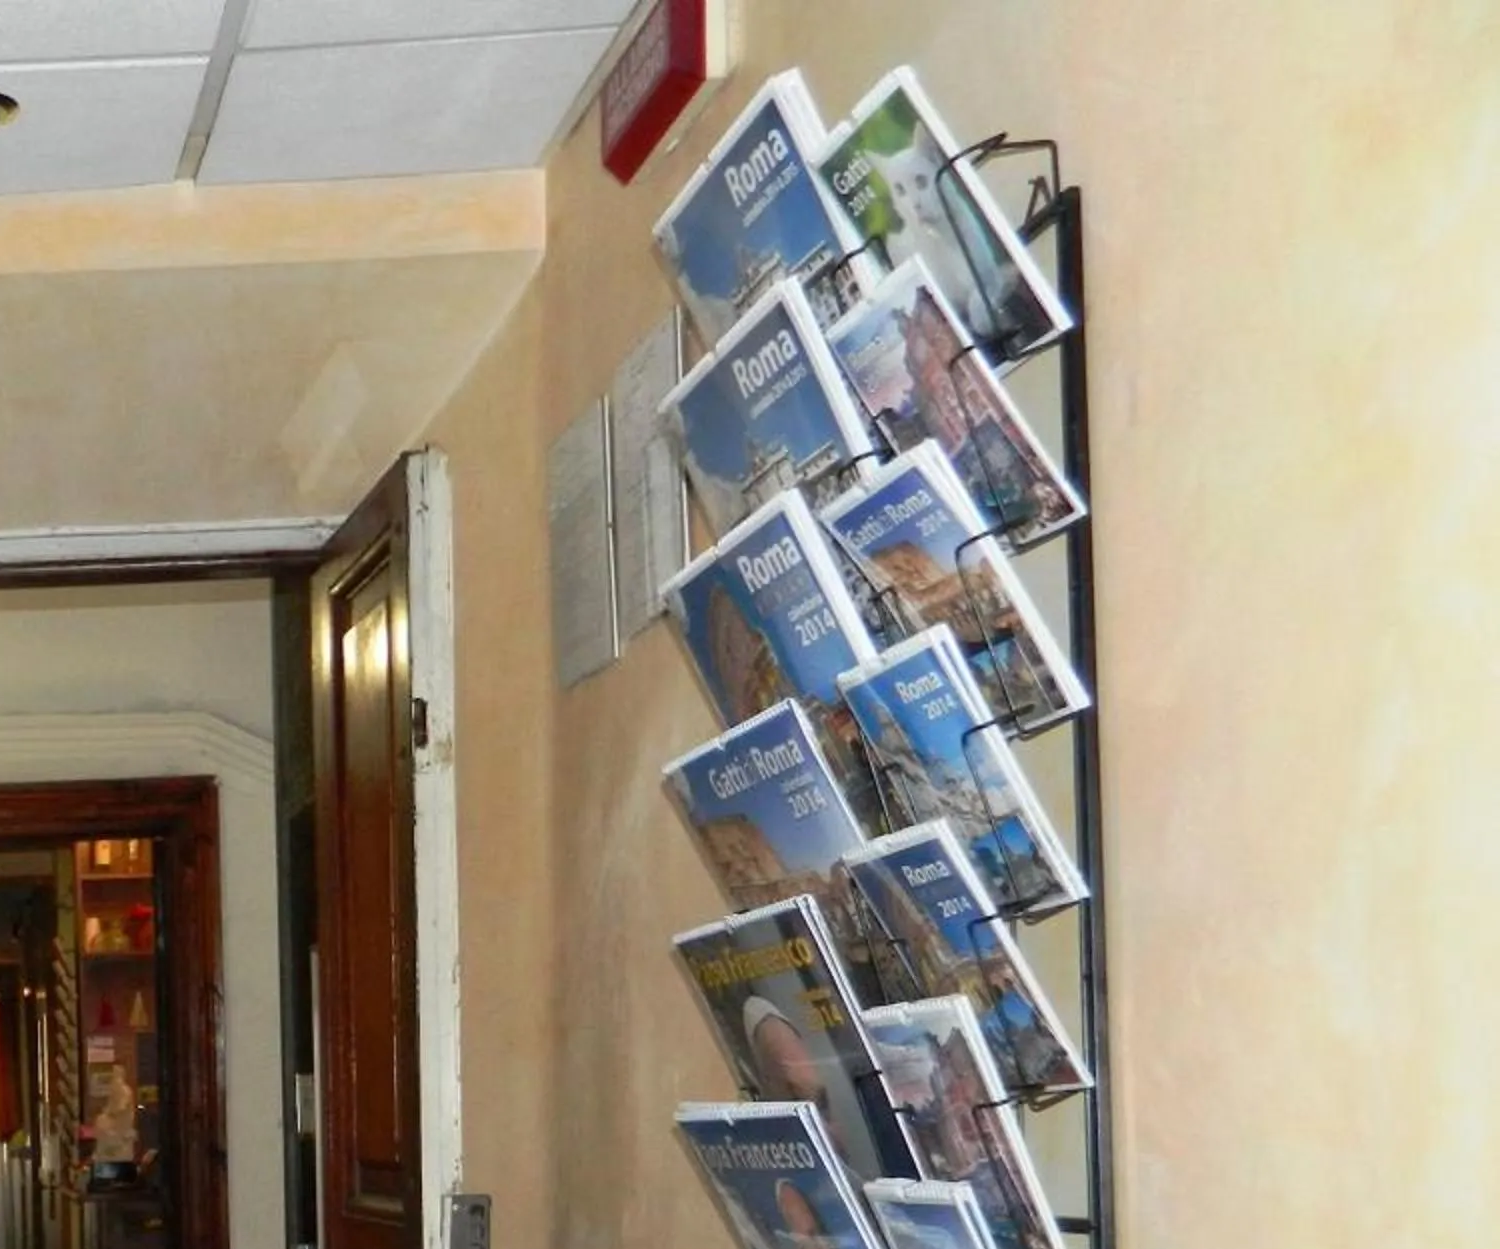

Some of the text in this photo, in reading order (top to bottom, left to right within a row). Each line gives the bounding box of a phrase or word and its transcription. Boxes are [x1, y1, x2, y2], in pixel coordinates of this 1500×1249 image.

[723, 129, 789, 208] Roma
[832, 150, 872, 196] Gatti
[847, 184, 878, 217] 2014
[731, 328, 799, 401] Roma
[883, 489, 933, 526] Roma
[736, 535, 803, 595] Roma
[794, 606, 837, 647] 2014
[894, 671, 944, 705] Roma
[707, 755, 749, 801] Gatti
[748, 738, 806, 781] Roma
[900, 860, 952, 889] Roma
[936, 895, 973, 919] 2014
[724, 1134, 815, 1169] Francesco
